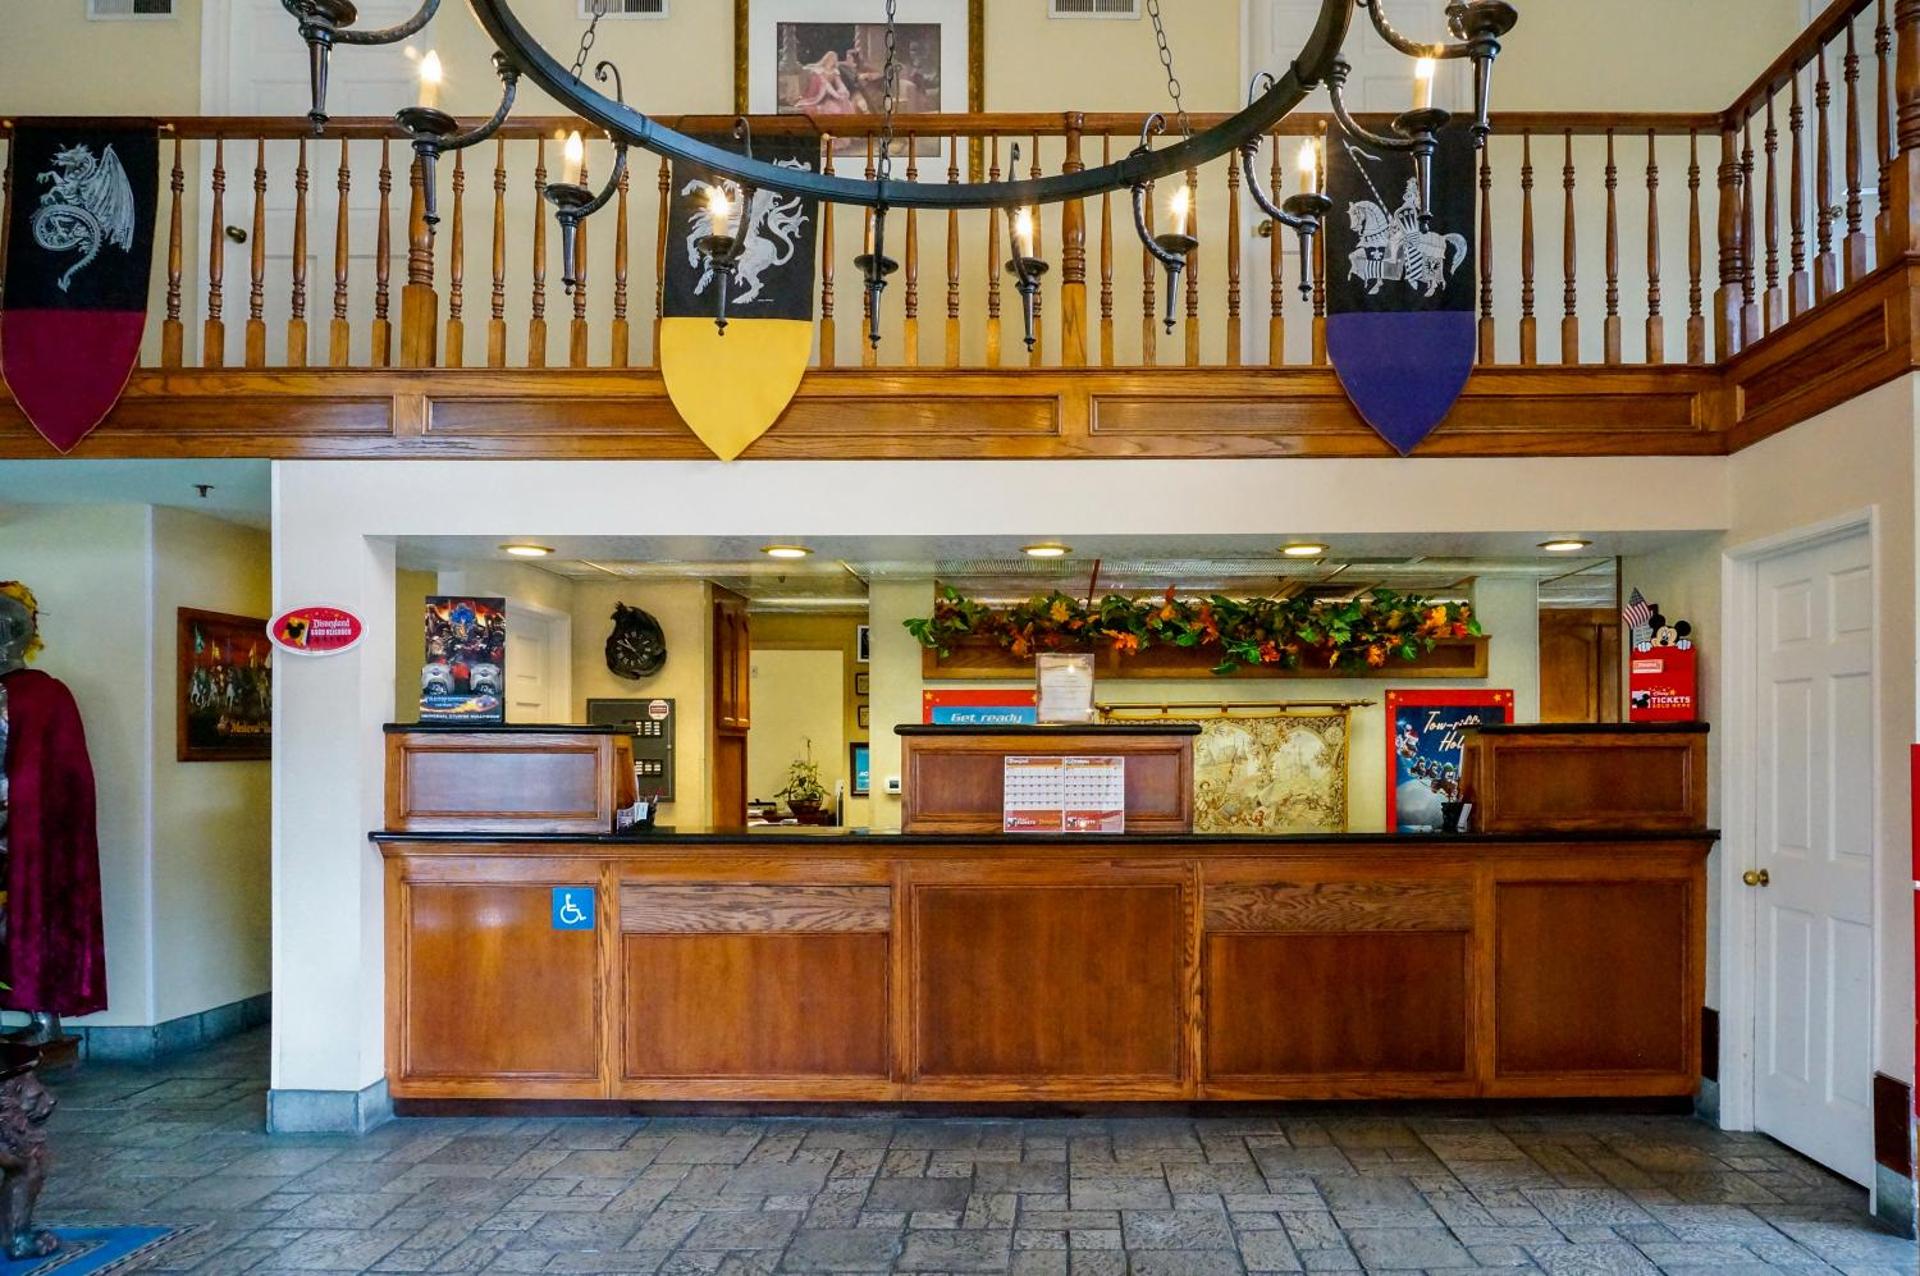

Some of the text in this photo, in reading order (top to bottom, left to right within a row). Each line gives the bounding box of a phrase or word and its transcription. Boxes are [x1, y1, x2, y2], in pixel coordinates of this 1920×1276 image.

[312, 618, 350, 629] Disneyland
[1652, 696, 1691, 704] TICKETS
[950, 713, 1023, 724] Get ready
